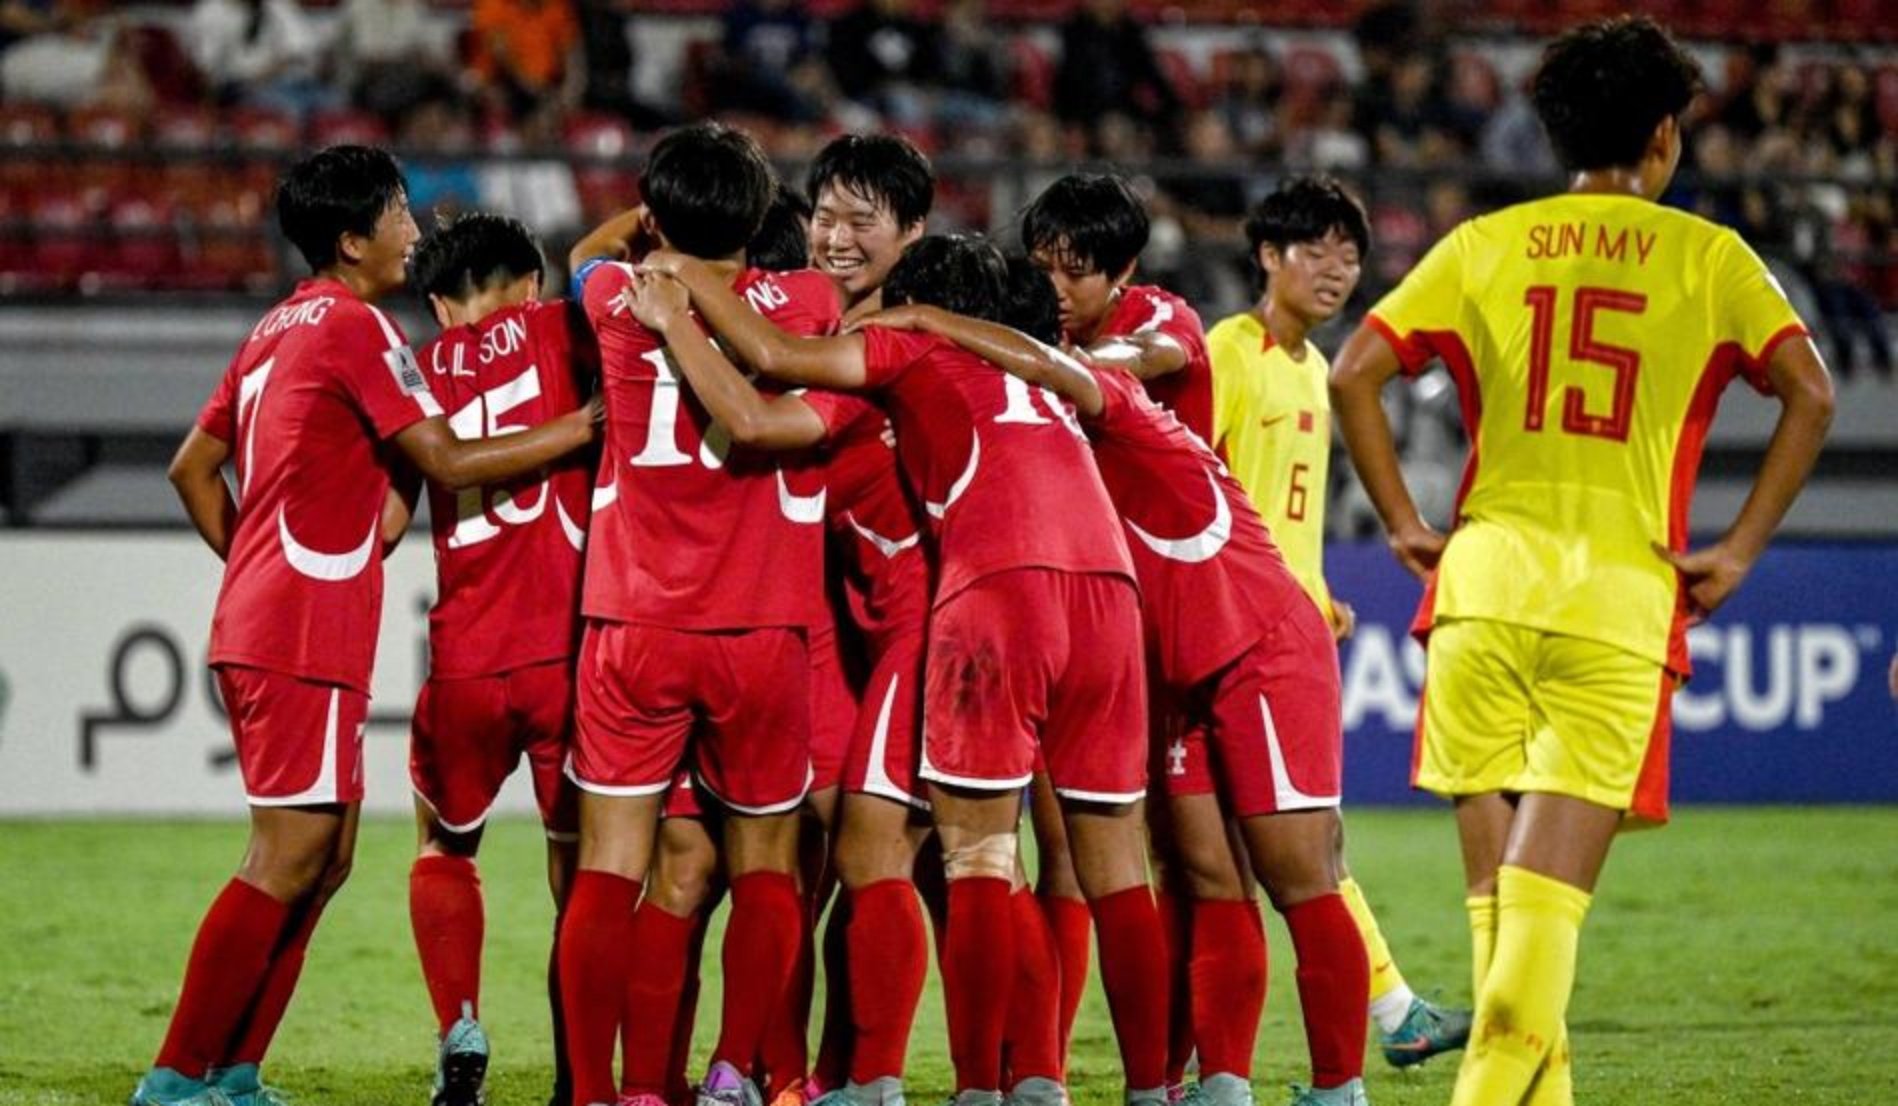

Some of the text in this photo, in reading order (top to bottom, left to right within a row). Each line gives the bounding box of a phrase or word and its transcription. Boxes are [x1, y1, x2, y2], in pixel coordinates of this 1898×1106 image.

[1526, 223, 1656, 264] SUN MY
[478, 312, 527, 364] SON
[1524, 286, 1648, 443] 15
[237, 356, 276, 500] 7
[1287, 462, 1309, 522] 6
[1671, 623, 1859, 729] CUP
